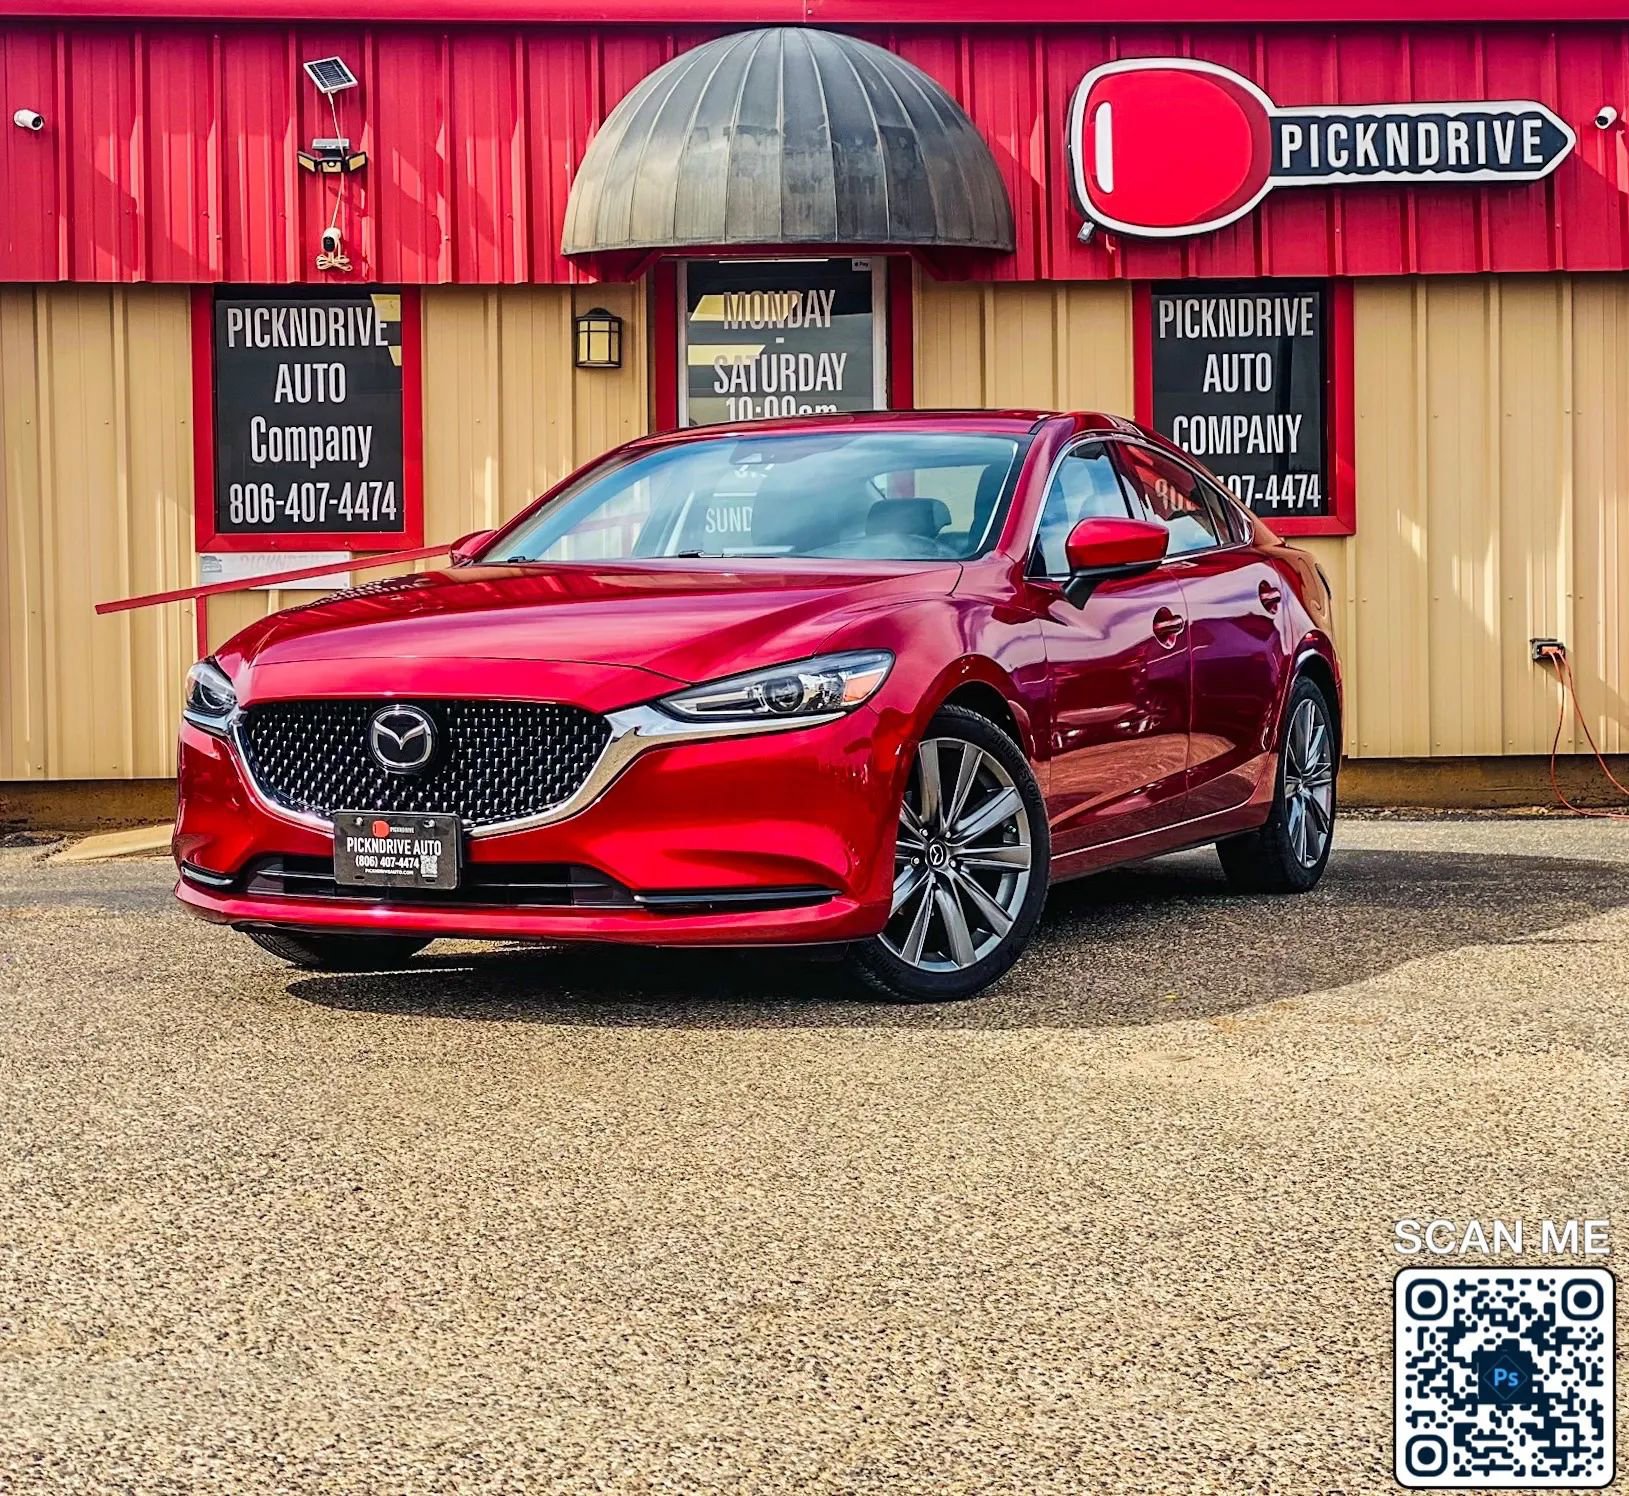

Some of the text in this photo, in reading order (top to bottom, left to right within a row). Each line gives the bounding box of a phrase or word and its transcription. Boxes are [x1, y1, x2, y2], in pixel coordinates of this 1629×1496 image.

[1281, 118, 1543, 168] PICKNDRIVE
[227, 307, 389, 348] PICKNDRIVE
[723, 289, 836, 330] MONDAY
[1159, 297, 1314, 339] PICKNDRIVE
[274, 362, 347, 404] AUTO
[713, 352, 847, 394] SATURDAY
[1202, 352, 1272, 393] AUTO
[250, 415, 373, 469] Company
[1173, 414, 1303, 456] COMPANY
[229, 481, 397, 524] 806-407-4474
[705, 506, 753, 534] SUND
[346, 836, 442, 857] PICKNDRIVE AUTO
[355, 854, 420, 869] (806) 407-4474
